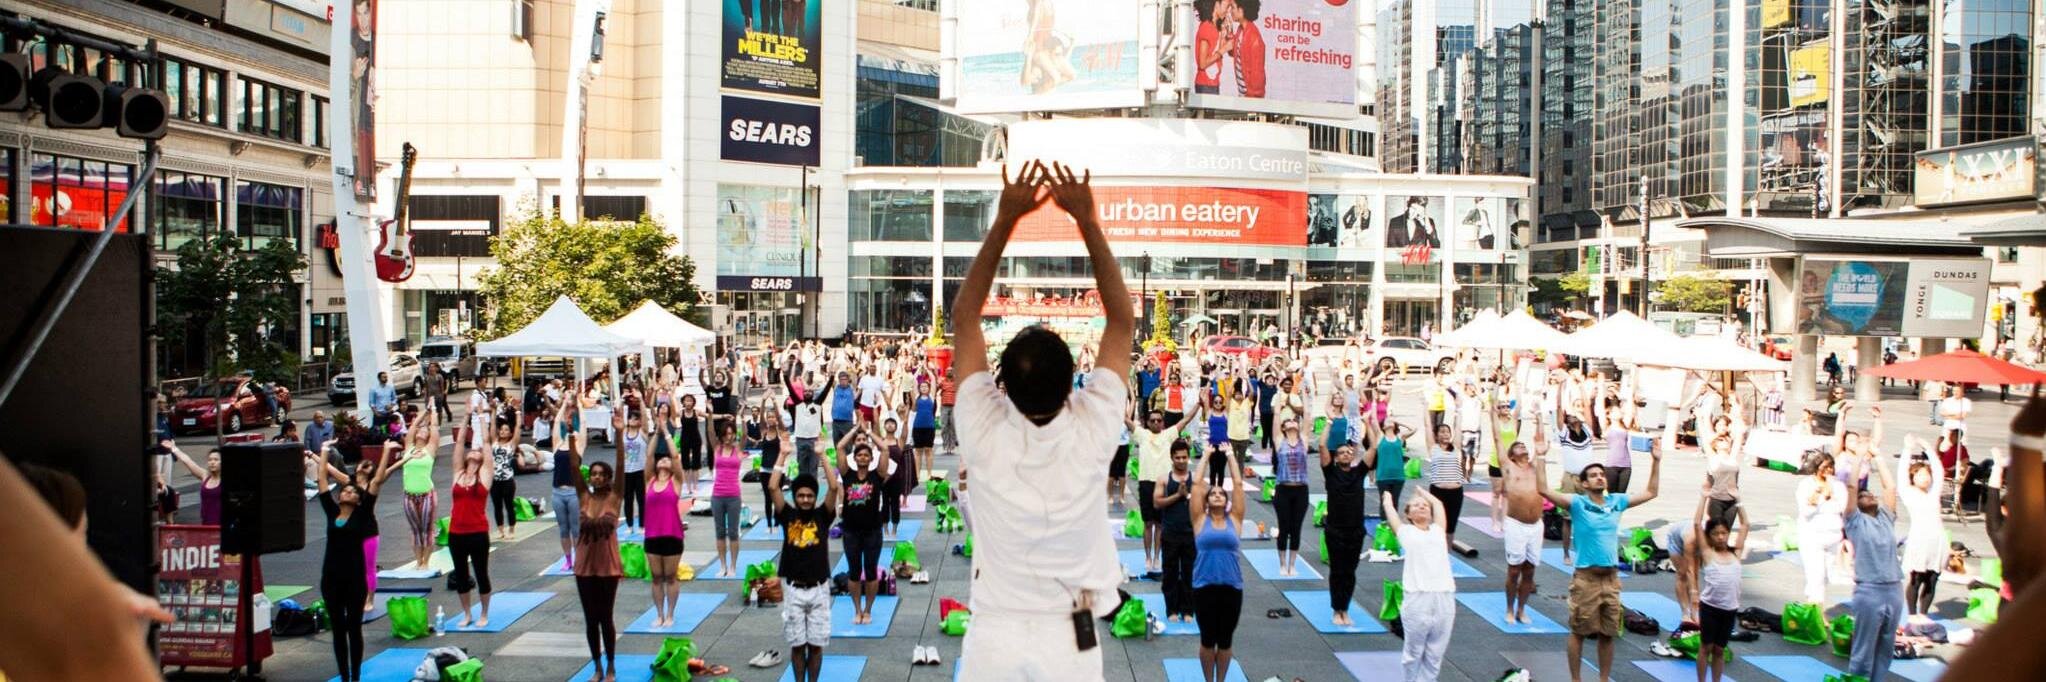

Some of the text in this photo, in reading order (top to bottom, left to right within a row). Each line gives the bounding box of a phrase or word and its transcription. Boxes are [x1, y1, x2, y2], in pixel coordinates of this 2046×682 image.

[1264, 14, 1321, 36] sharing
[745, 31, 799, 47] WE'RE THE
[1277, 34, 1310, 45] can be
[738, 38, 806, 63] MILLERS
[1275, 46, 1352, 69] refreshing
[729, 118, 812, 148] SEARS
[1185, 152, 1303, 174] Eaton Centre
[1100, 198, 1259, 229] urban eatery
[1139, 228, 1157, 236] NEW
[1193, 229, 1241, 238] EXPERIENCE
[751, 278, 793, 290] SEARS
[1934, 271, 1977, 279] DUNDAS
[1916, 284, 1927, 319] YONGE
[161, 544, 221, 572] INDIE
